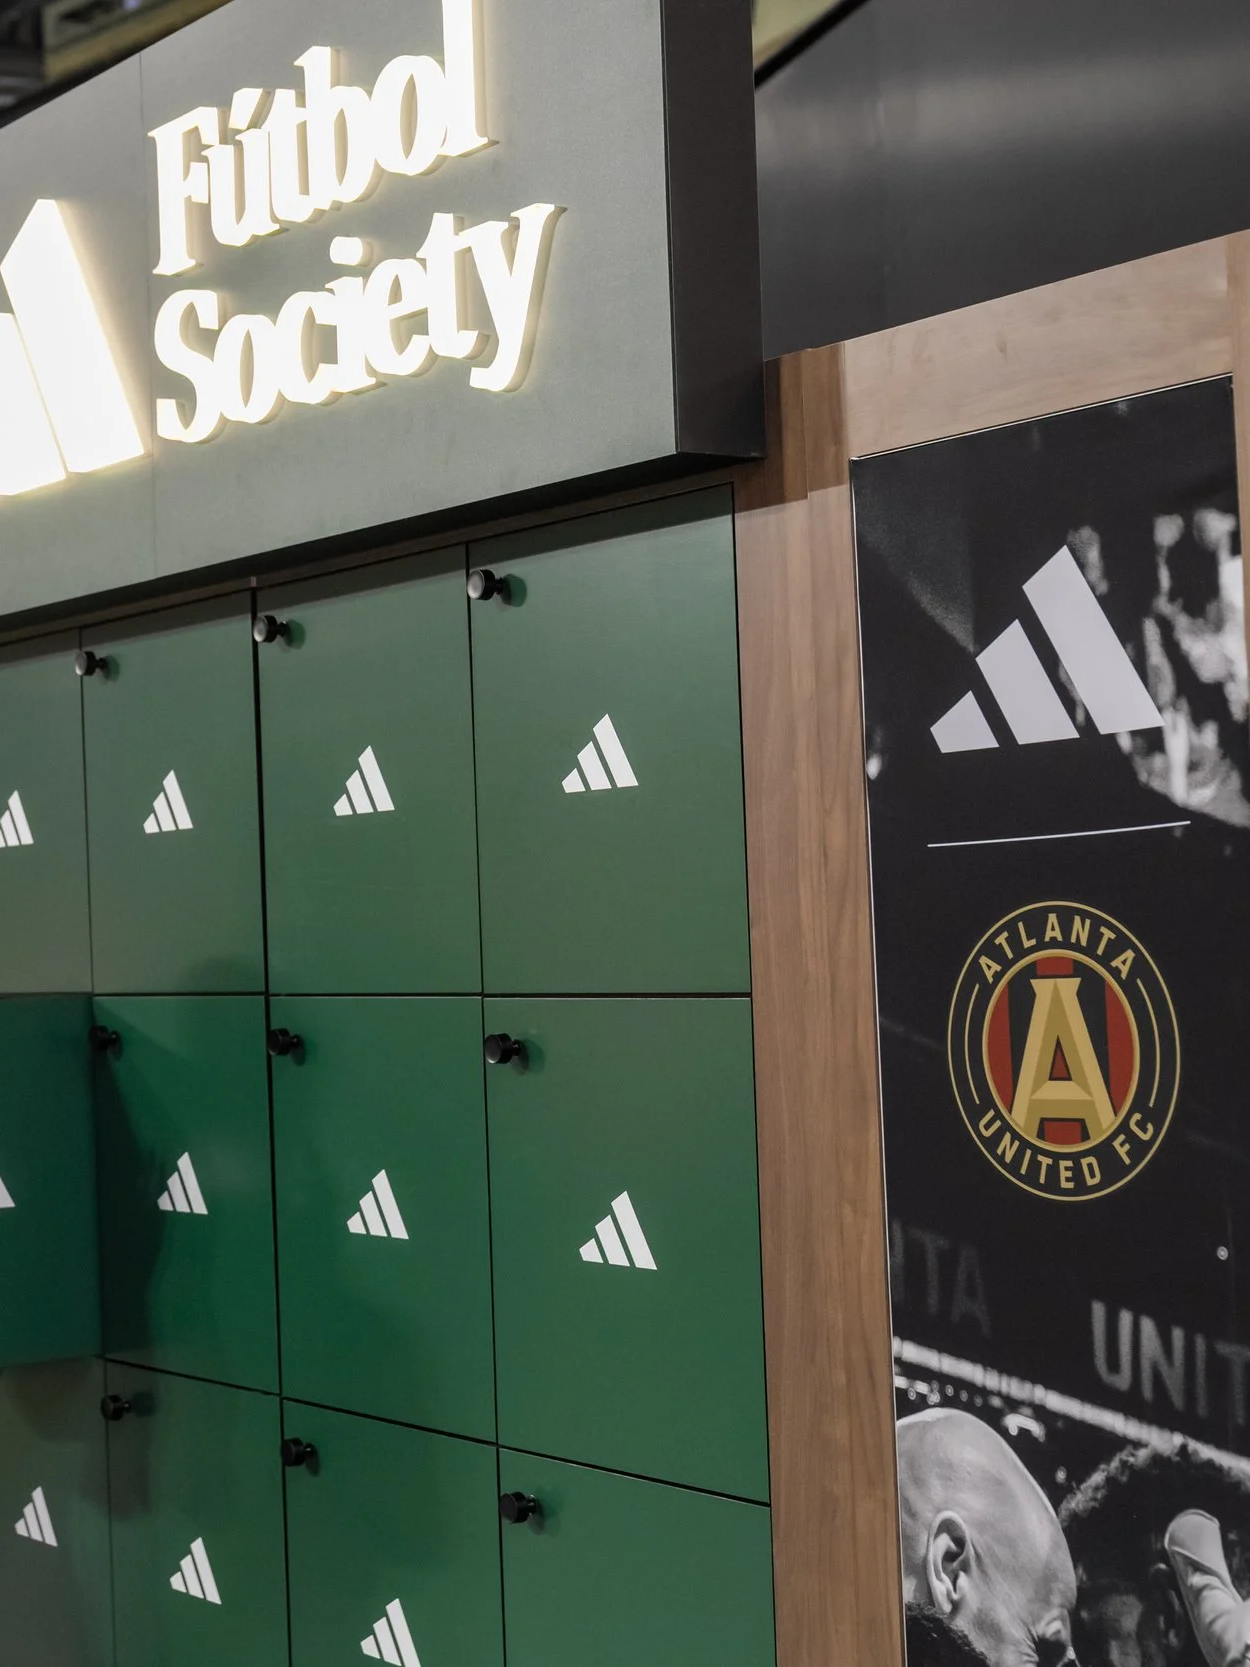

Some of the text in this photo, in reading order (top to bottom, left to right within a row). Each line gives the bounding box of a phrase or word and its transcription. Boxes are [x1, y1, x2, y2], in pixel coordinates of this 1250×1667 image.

[148, 0, 492, 276] Fútbol
[153, 202, 558, 443] Society
[978, 912, 1136, 984] ATLANTA
[1010, 976, 1117, 1142] A
[978, 1108, 1155, 1189] UNITED FC
